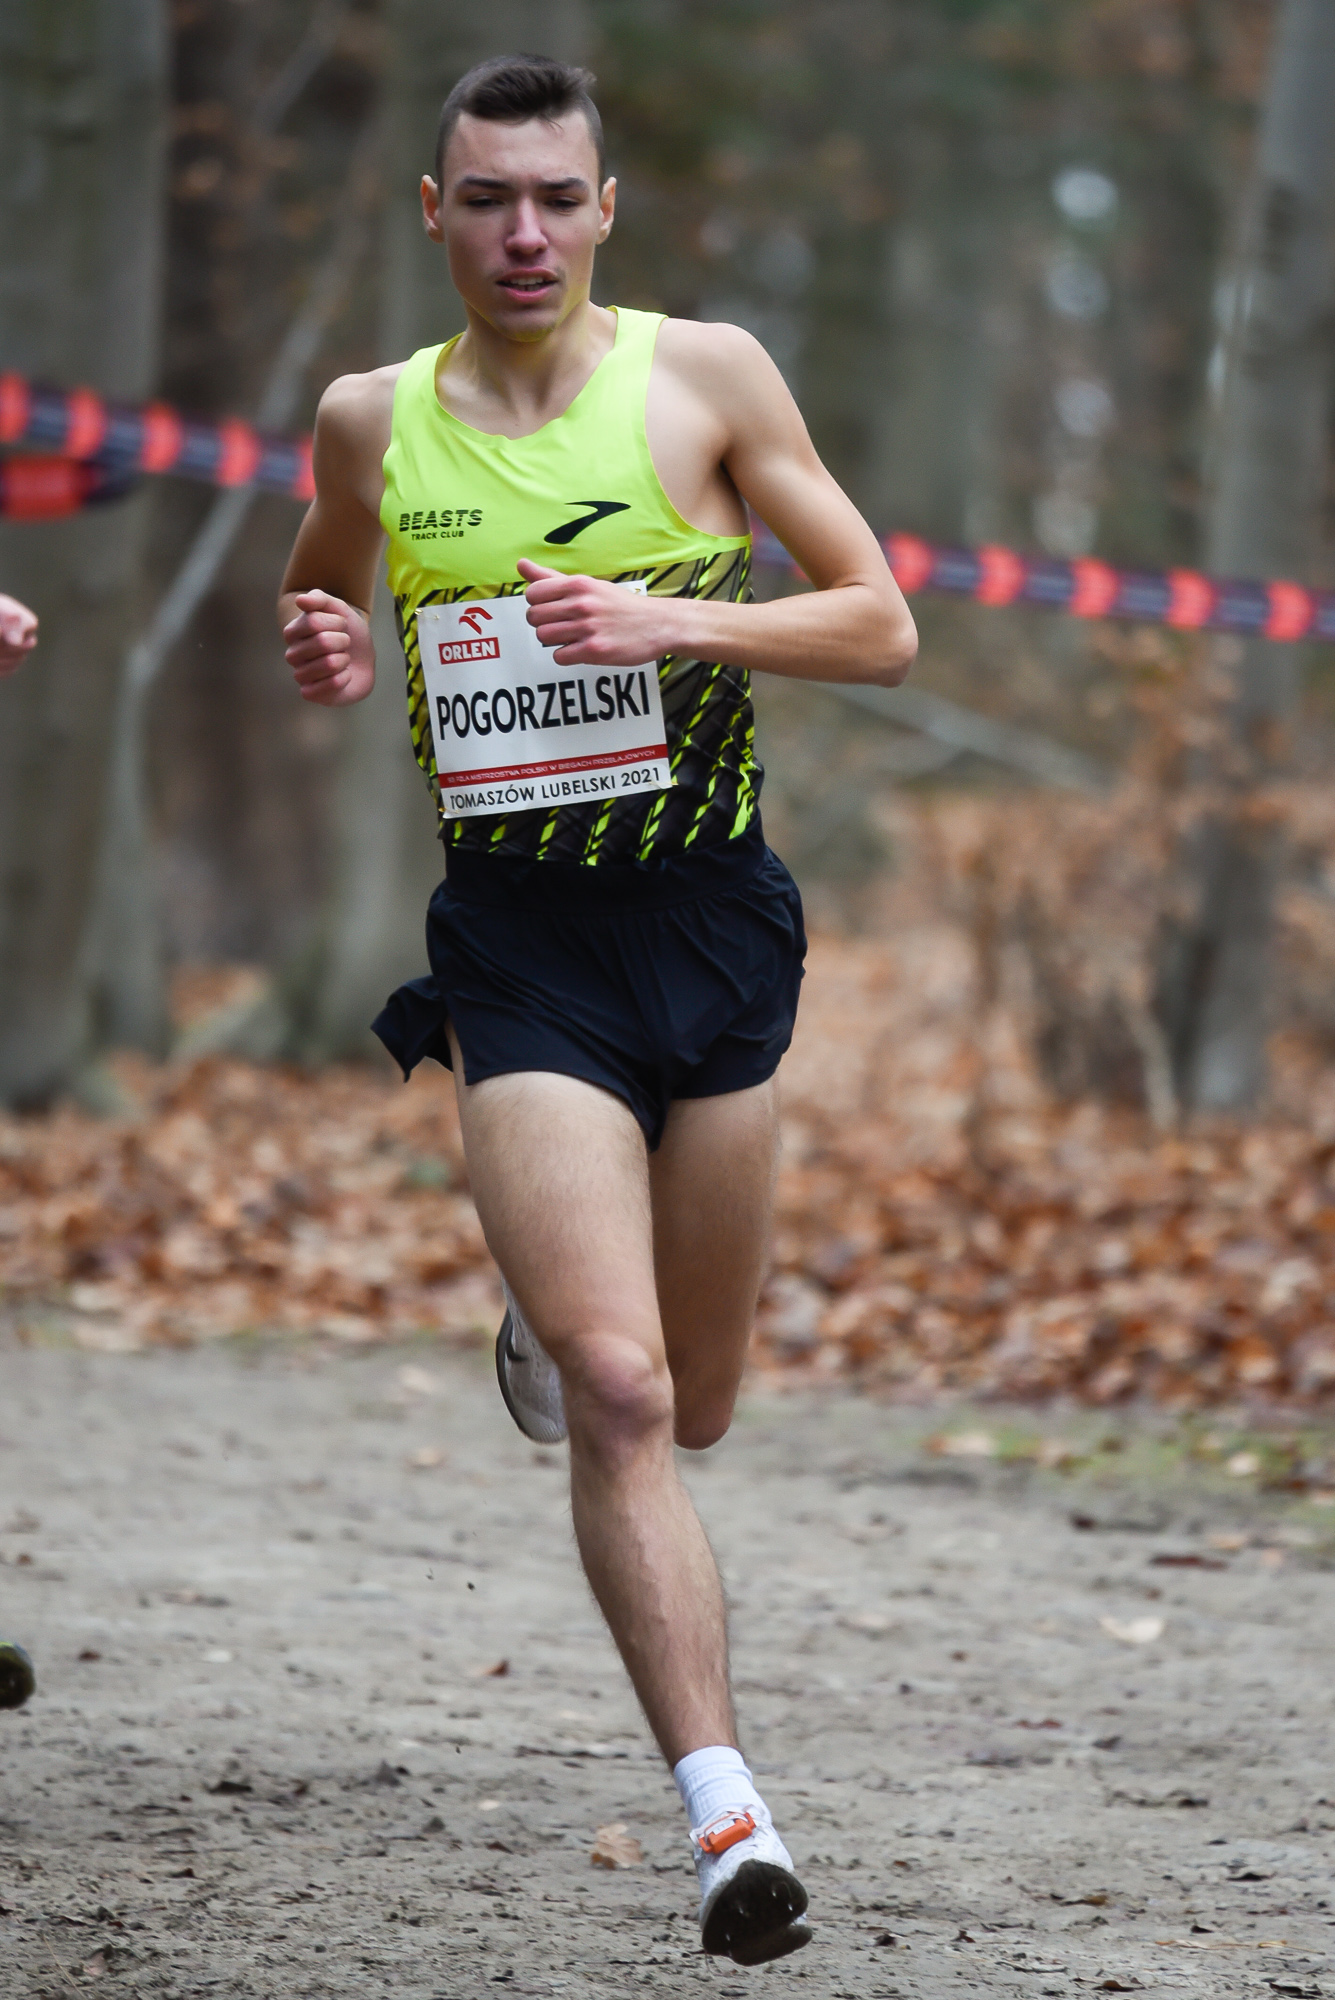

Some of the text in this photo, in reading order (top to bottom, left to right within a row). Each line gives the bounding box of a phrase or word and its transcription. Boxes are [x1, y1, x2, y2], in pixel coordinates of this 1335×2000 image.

[399, 508, 483, 532] BEASTS
[411, 530, 464, 541] TRACK CLUB
[441, 640, 496, 662] ORLEN
[436, 671, 651, 741] POGORZELSKI
[450, 767, 660, 810] TOMASZÓW LUBELSKI 2021
